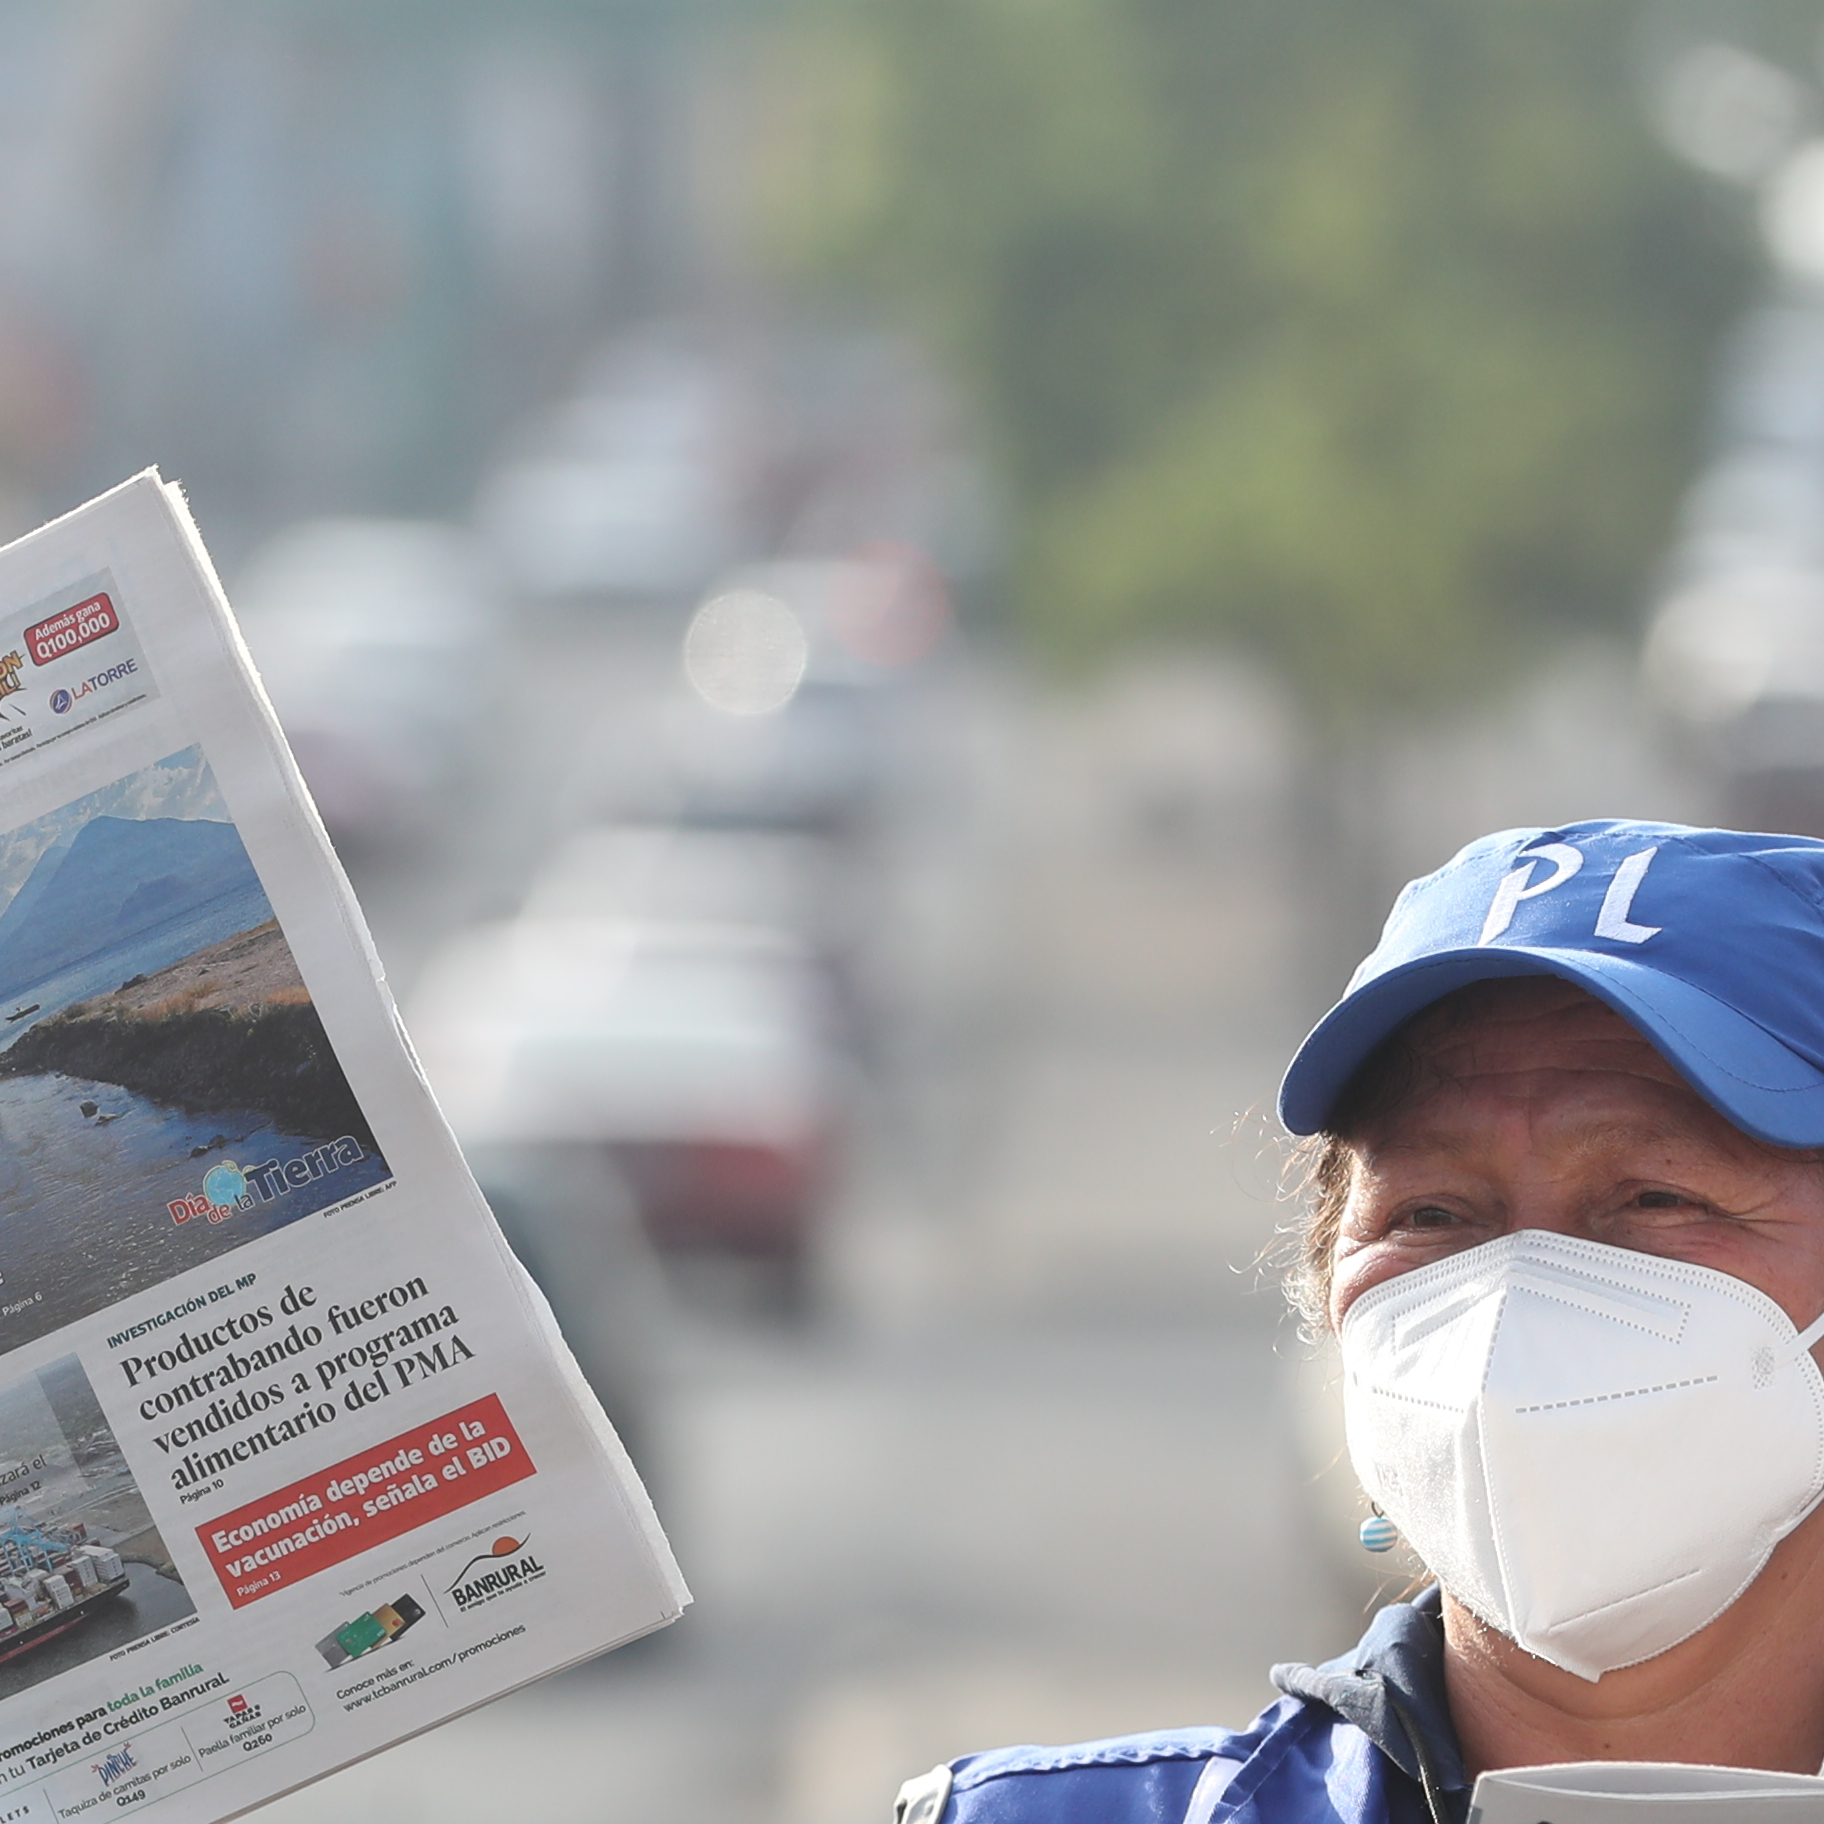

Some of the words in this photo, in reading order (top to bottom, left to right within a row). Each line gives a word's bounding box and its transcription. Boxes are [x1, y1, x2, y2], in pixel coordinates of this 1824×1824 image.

[33, 613, 76, 641] Además
[74, 601, 101, 622] gana
[35, 612, 111, 659] Q100,000
[167, 1190, 209, 1225] Día
[207, 1201, 231, 1224] de
[232, 1189, 254, 1211] la
[245, 1126, 361, 1203] Tierra
[106, 1294, 207, 1349] INVESTIGACIÓN
[207, 1283, 235, 1303] DEL
[234, 1272, 257, 1290] MP
[119, 1302, 274, 1388] Productos
[277, 1281, 317, 1316] de
[137, 1320, 323, 1422] contrabando
[326, 1273, 429, 1336] fueron
[151, 1379, 285, 1455] vendidos
[290, 1372, 311, 1395] a
[314, 1303, 461, 1391] programa
[168, 1397, 337, 1491] alimentario
[341, 1368, 390, 1412] del
[391, 1332, 475, 1389] PMA
[29, 1452, 47, 1470] el
[210, 1491, 323, 1554] Economía
[324, 1445, 425, 1504] depende
[426, 1430, 459, 1456] de
[458, 1418, 486, 1441] la
[224, 1508, 360, 1580] vacunación,
[361, 1471, 439, 1518] señala
[440, 1455, 466, 1481] el
[465, 1435, 512, 1470] BID
[451, 1553, 544, 1609] BANRURAL
[75, 1706, 108, 1730] para
[106, 1691, 140, 1713] toda
[138, 1684, 156, 1698] la
[154, 1661, 204, 1691] familia
